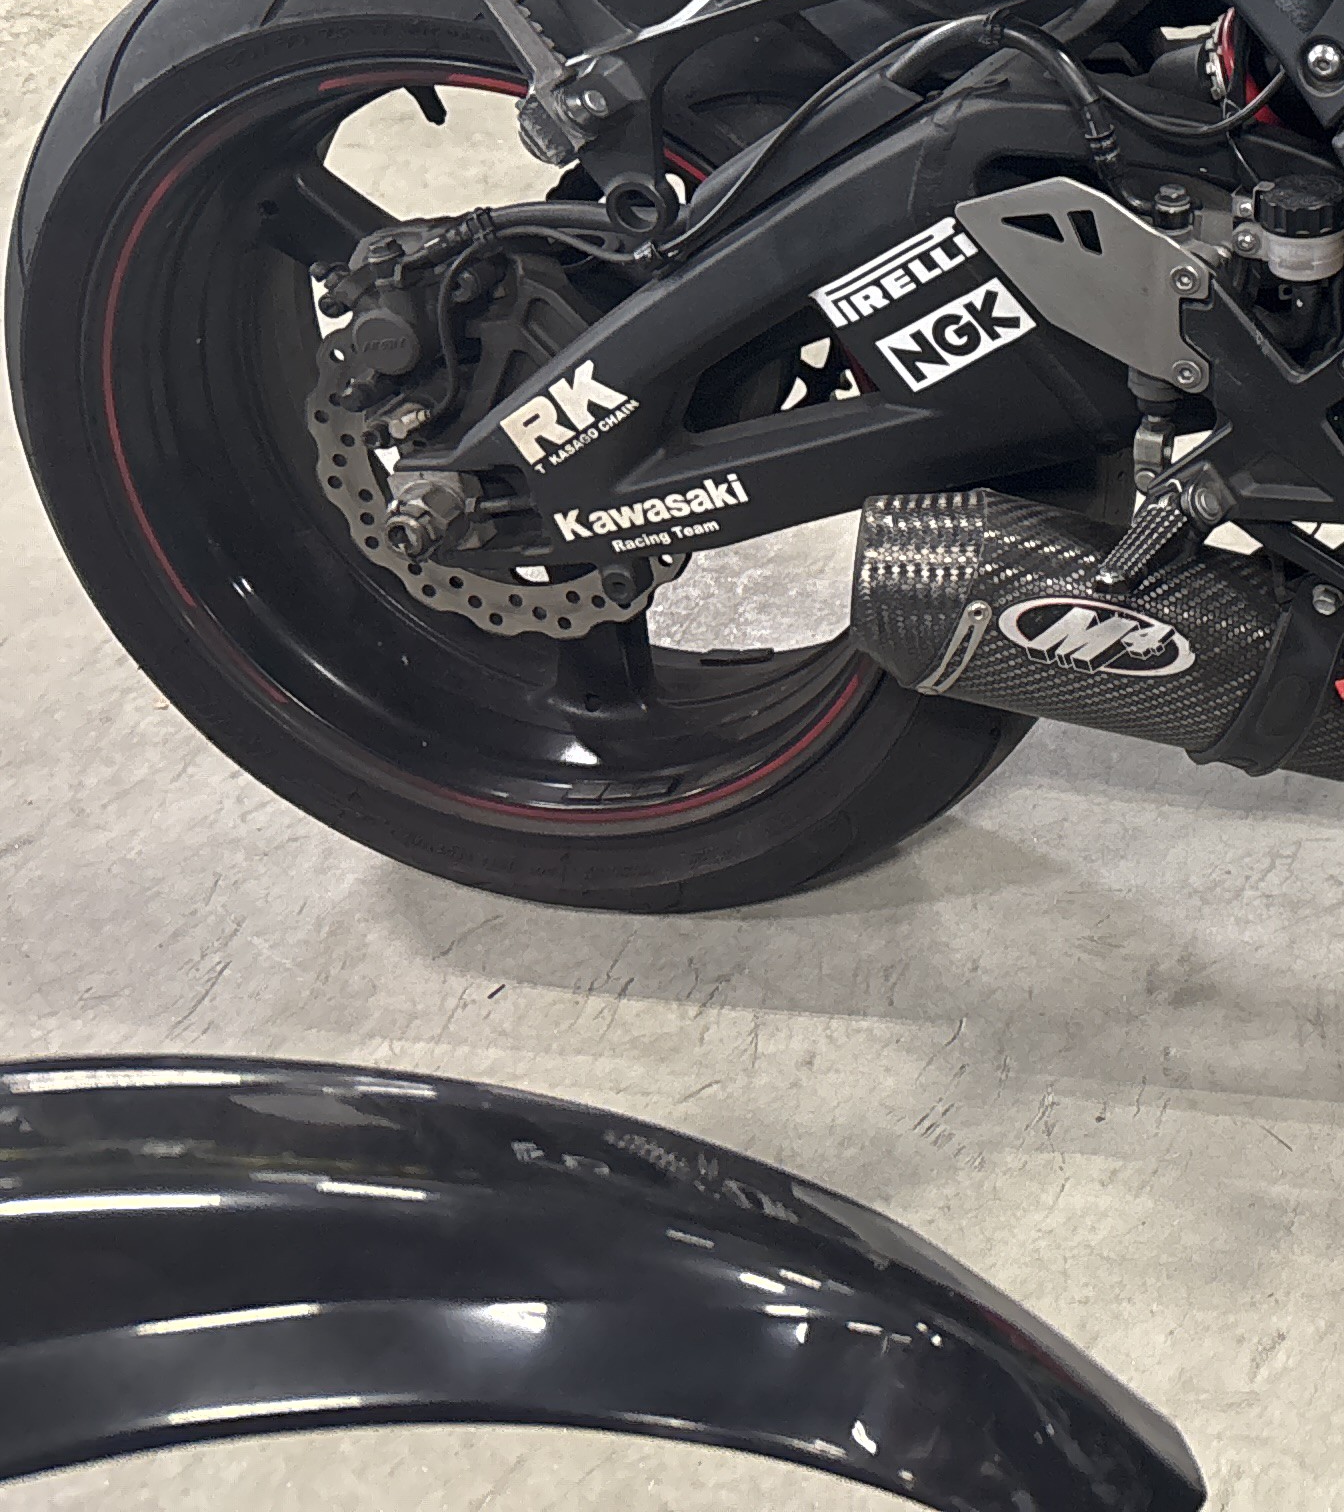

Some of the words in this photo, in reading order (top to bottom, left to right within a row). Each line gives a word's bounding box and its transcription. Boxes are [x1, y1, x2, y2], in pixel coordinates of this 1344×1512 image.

[808, 216, 980, 329] PIRELLI
[898, 288, 1022, 385] NGK
[499, 359, 630, 466] RK
[533, 427, 599, 475] TKASAGO
[598, 399, 641, 432] CHAIN
[553, 473, 750, 543] Kawasaki
[611, 529, 672, 554] Racing
[671, 520, 721, 539] Team
[1026, 605, 1177, 675] M4
